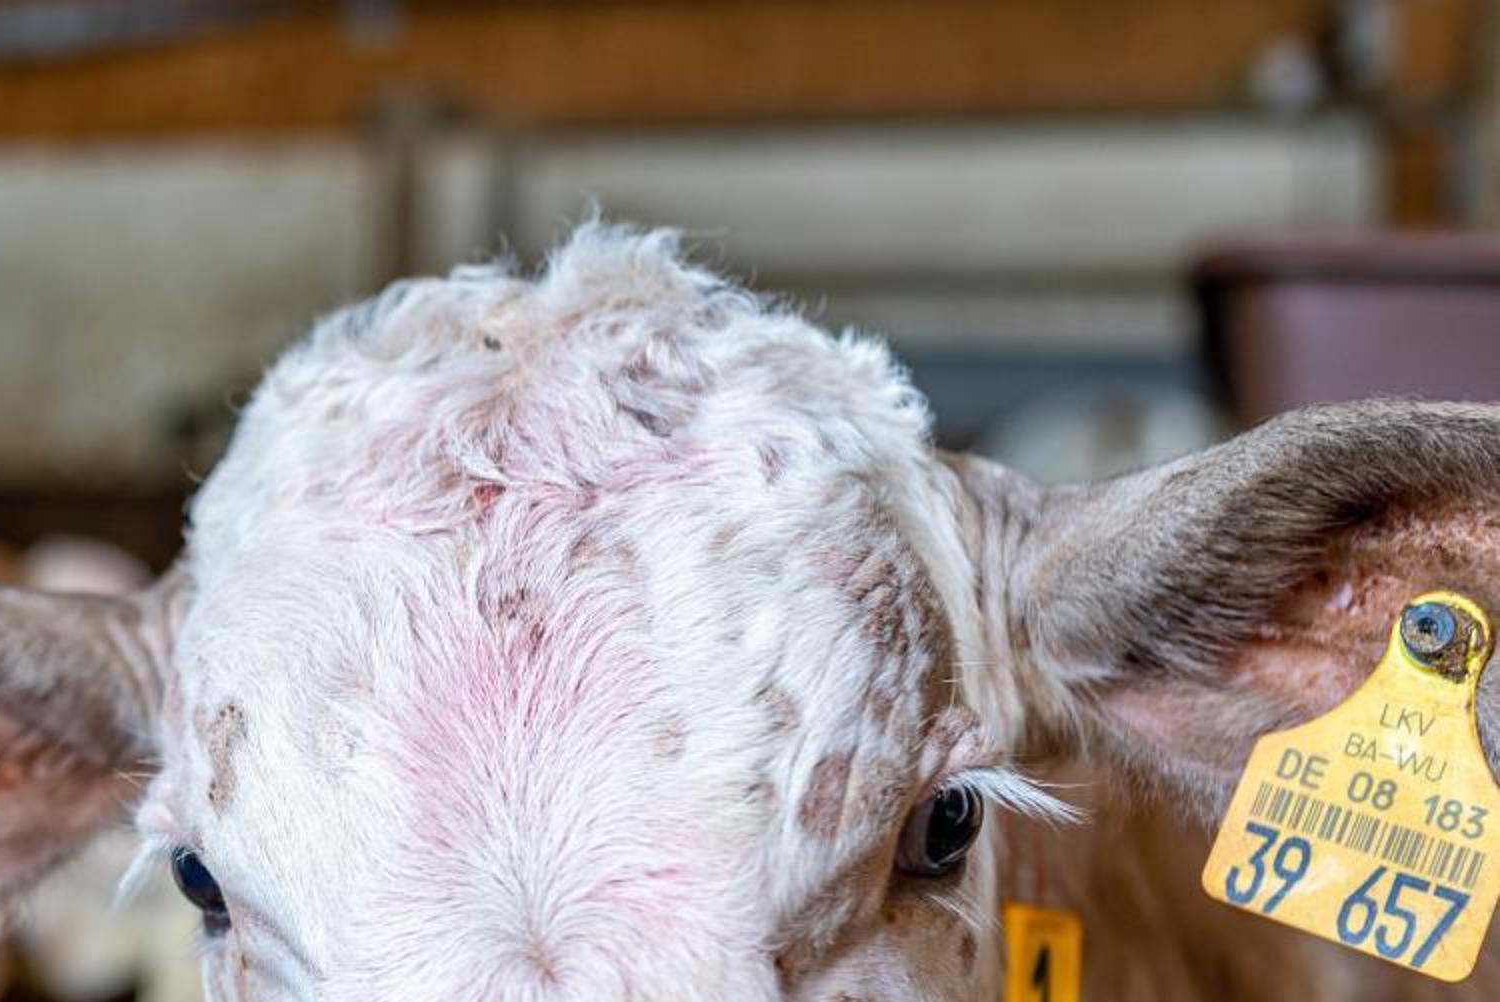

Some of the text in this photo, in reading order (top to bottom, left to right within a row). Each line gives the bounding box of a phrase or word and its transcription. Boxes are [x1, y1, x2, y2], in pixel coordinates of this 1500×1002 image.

[1380, 704, 1435, 735] LKV
[1345, 733, 1446, 782] BA-WU
[1277, 748, 1489, 839] DE 08 183
[1225, 821, 1470, 968] 39 657
